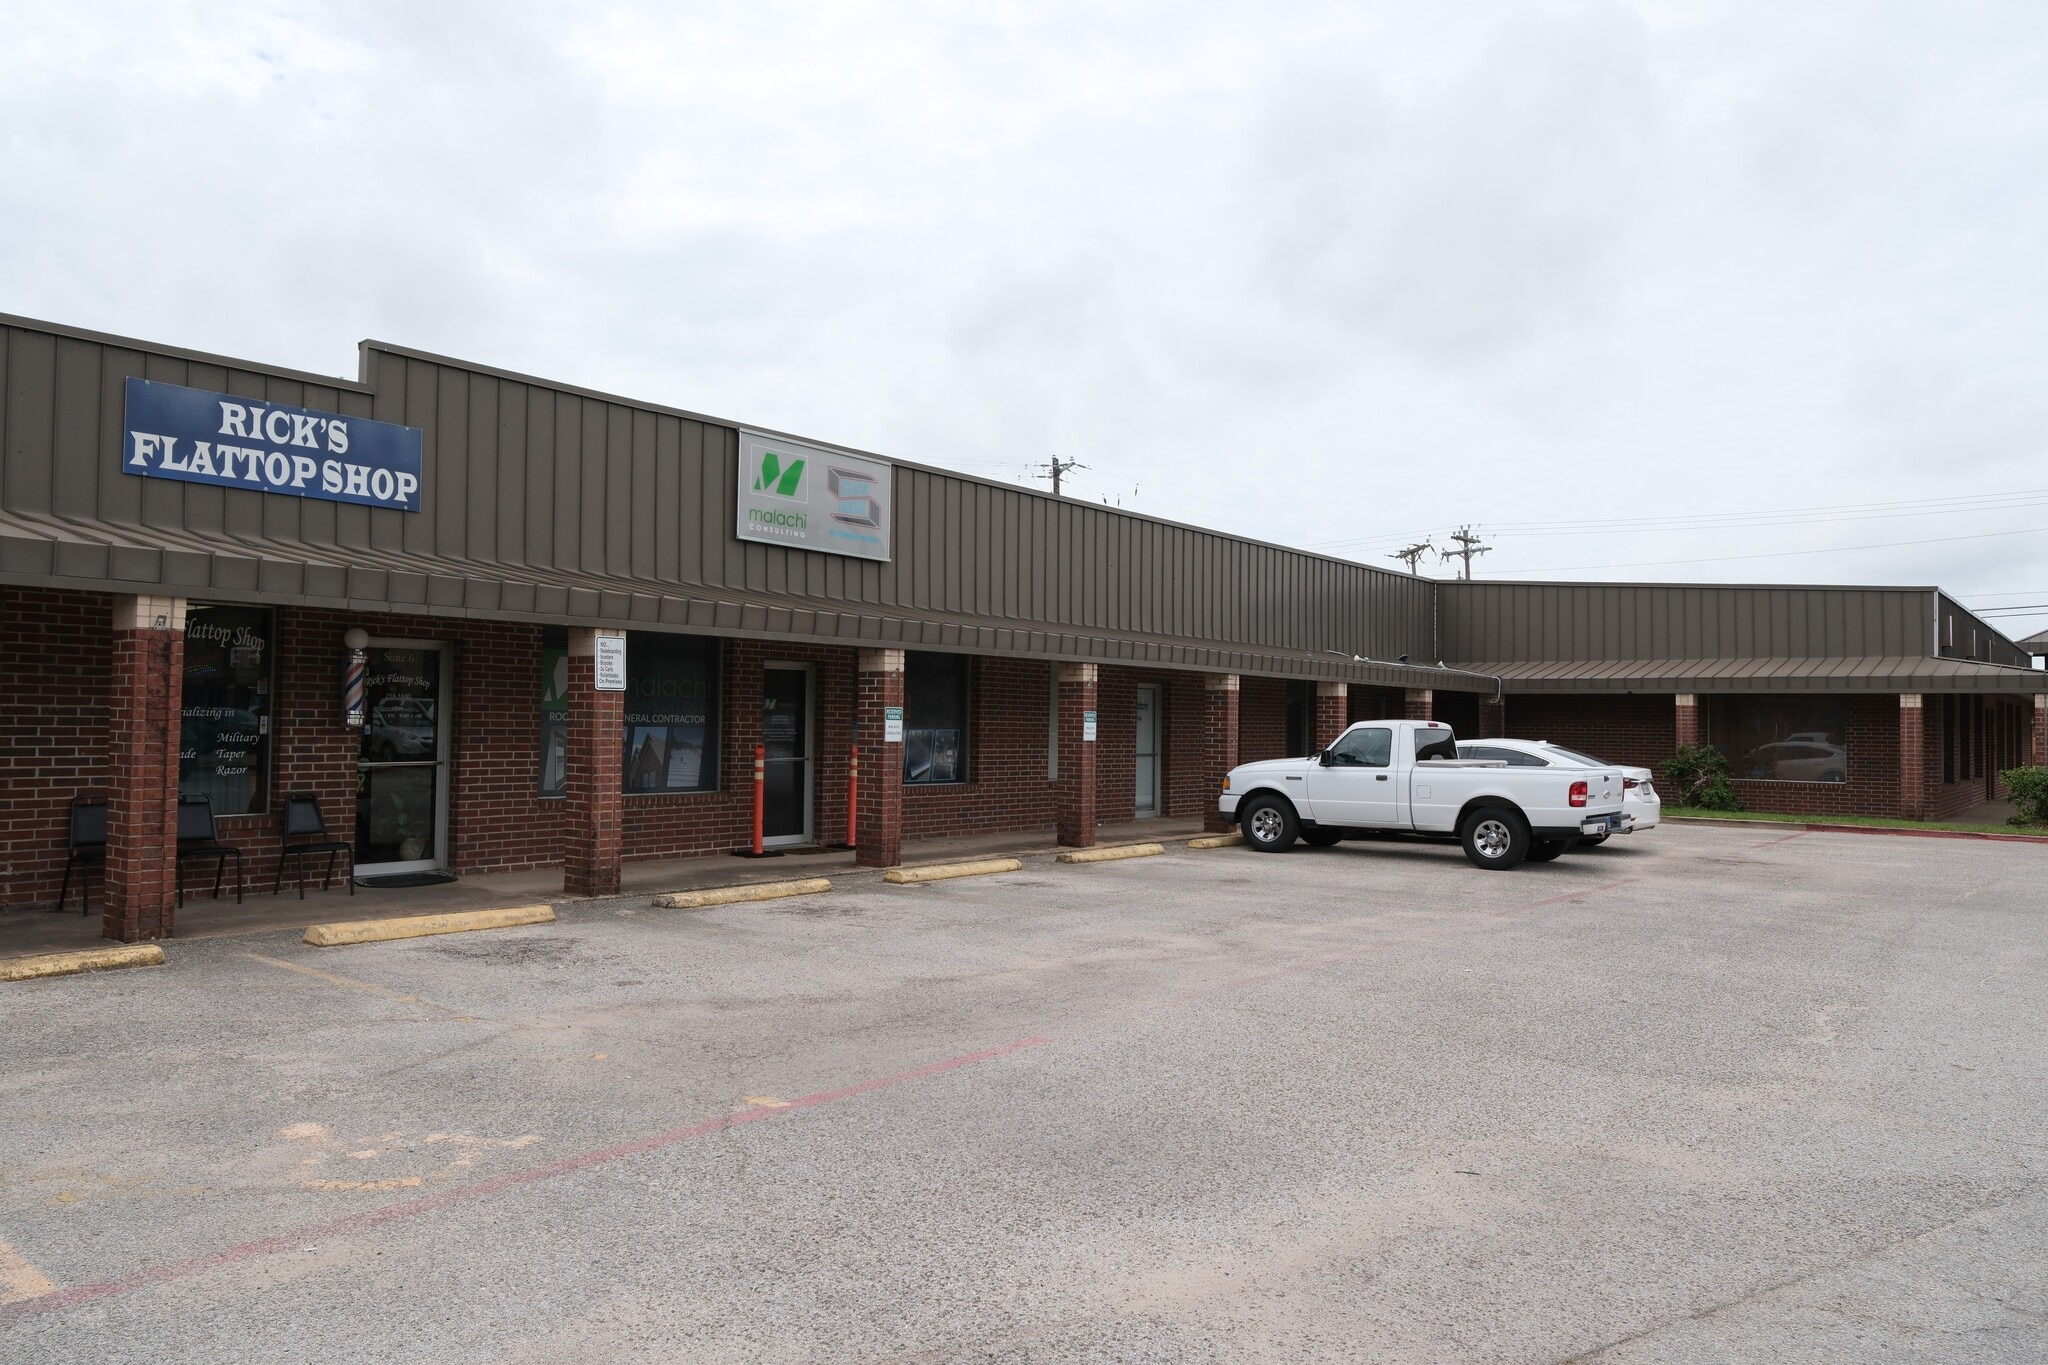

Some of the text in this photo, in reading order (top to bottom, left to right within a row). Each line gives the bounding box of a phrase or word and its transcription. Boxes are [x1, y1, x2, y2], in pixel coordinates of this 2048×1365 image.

[218, 401, 349, 454] RICK'S
[129, 431, 418, 502] FLATTOP SHOP
[749, 508, 807, 529] malachi
[750, 524, 806, 539] CONSULTING
[233, 626, 265, 656] Shop
[386, 673, 414, 687] Flattop
[414, 676, 431, 690] Shop
[224, 708, 235, 717] in
[652, 714, 706, 724] CONTRACTOR
[216, 731, 260, 745] Military
[215, 748, 247, 761] Taper
[215, 765, 248, 776] Razor
